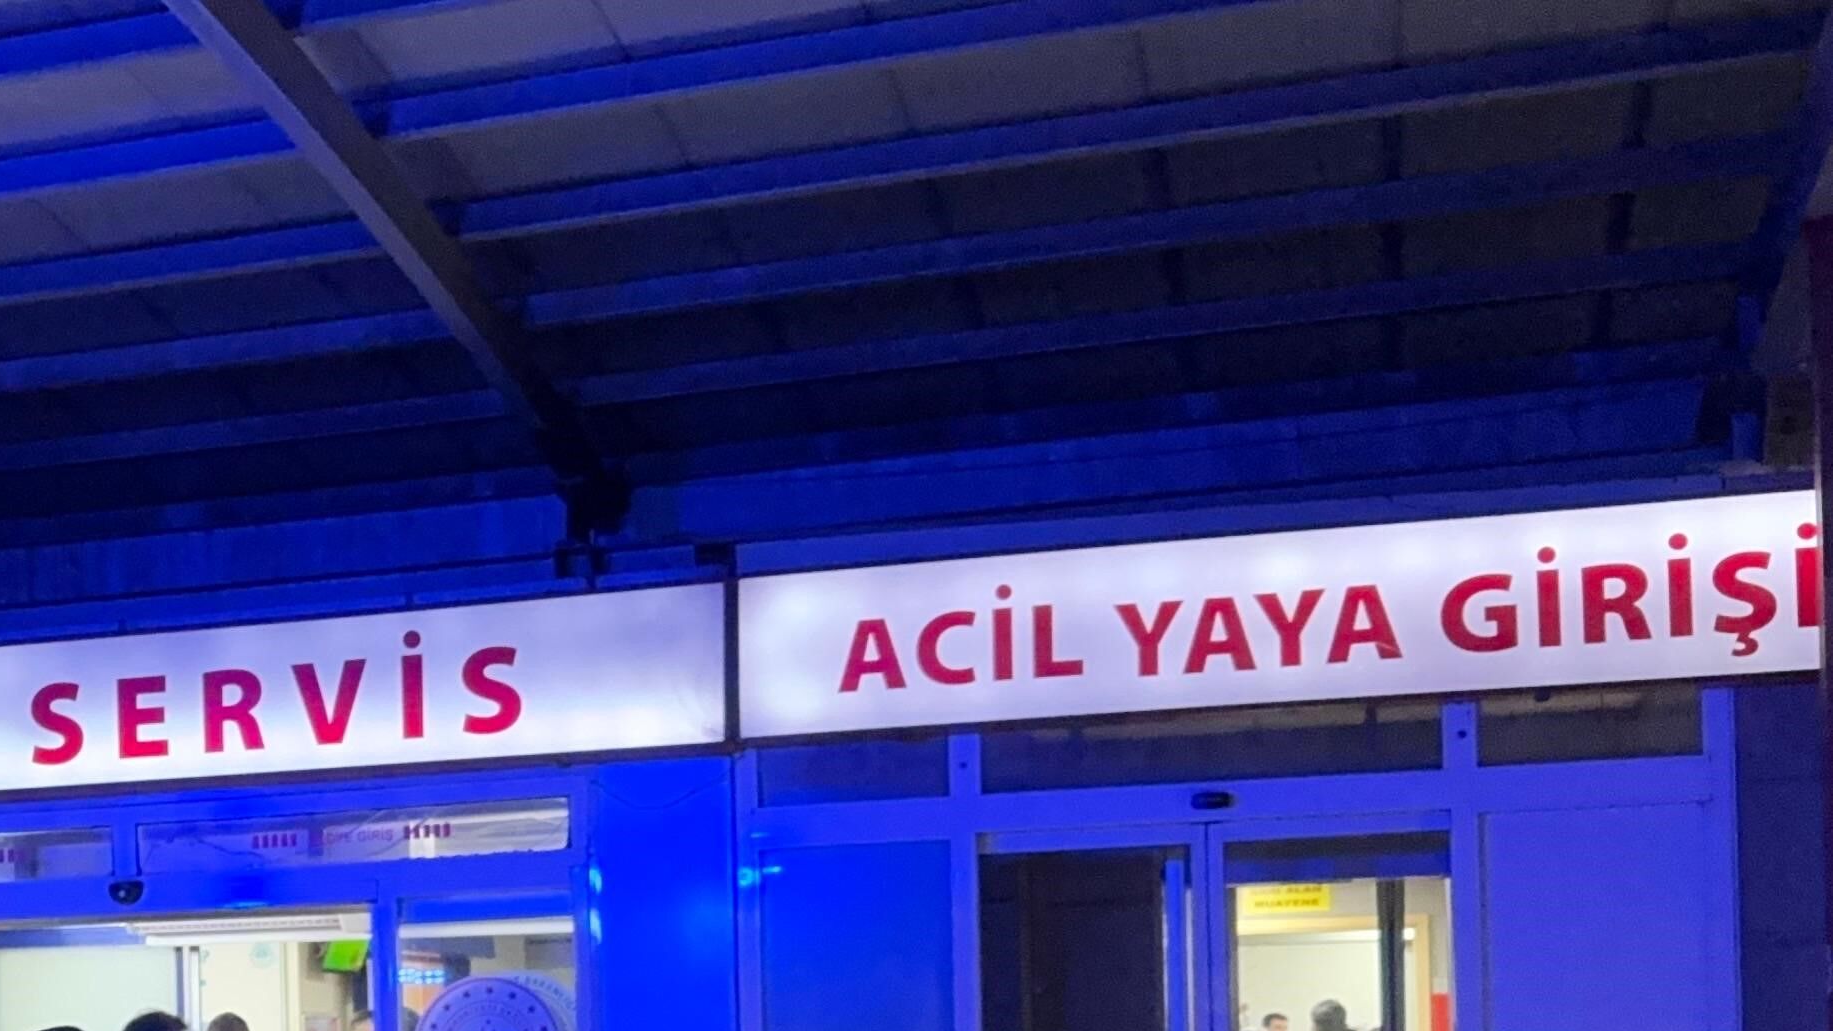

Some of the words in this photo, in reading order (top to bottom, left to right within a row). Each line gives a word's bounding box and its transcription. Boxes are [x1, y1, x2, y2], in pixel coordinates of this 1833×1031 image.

[838, 583, 1084, 693] ACİL
[1114, 586, 1403, 676] YAYA
[1440, 522, 1824, 656] GİRİŞİ
[31, 630, 524, 766] SERVİS
